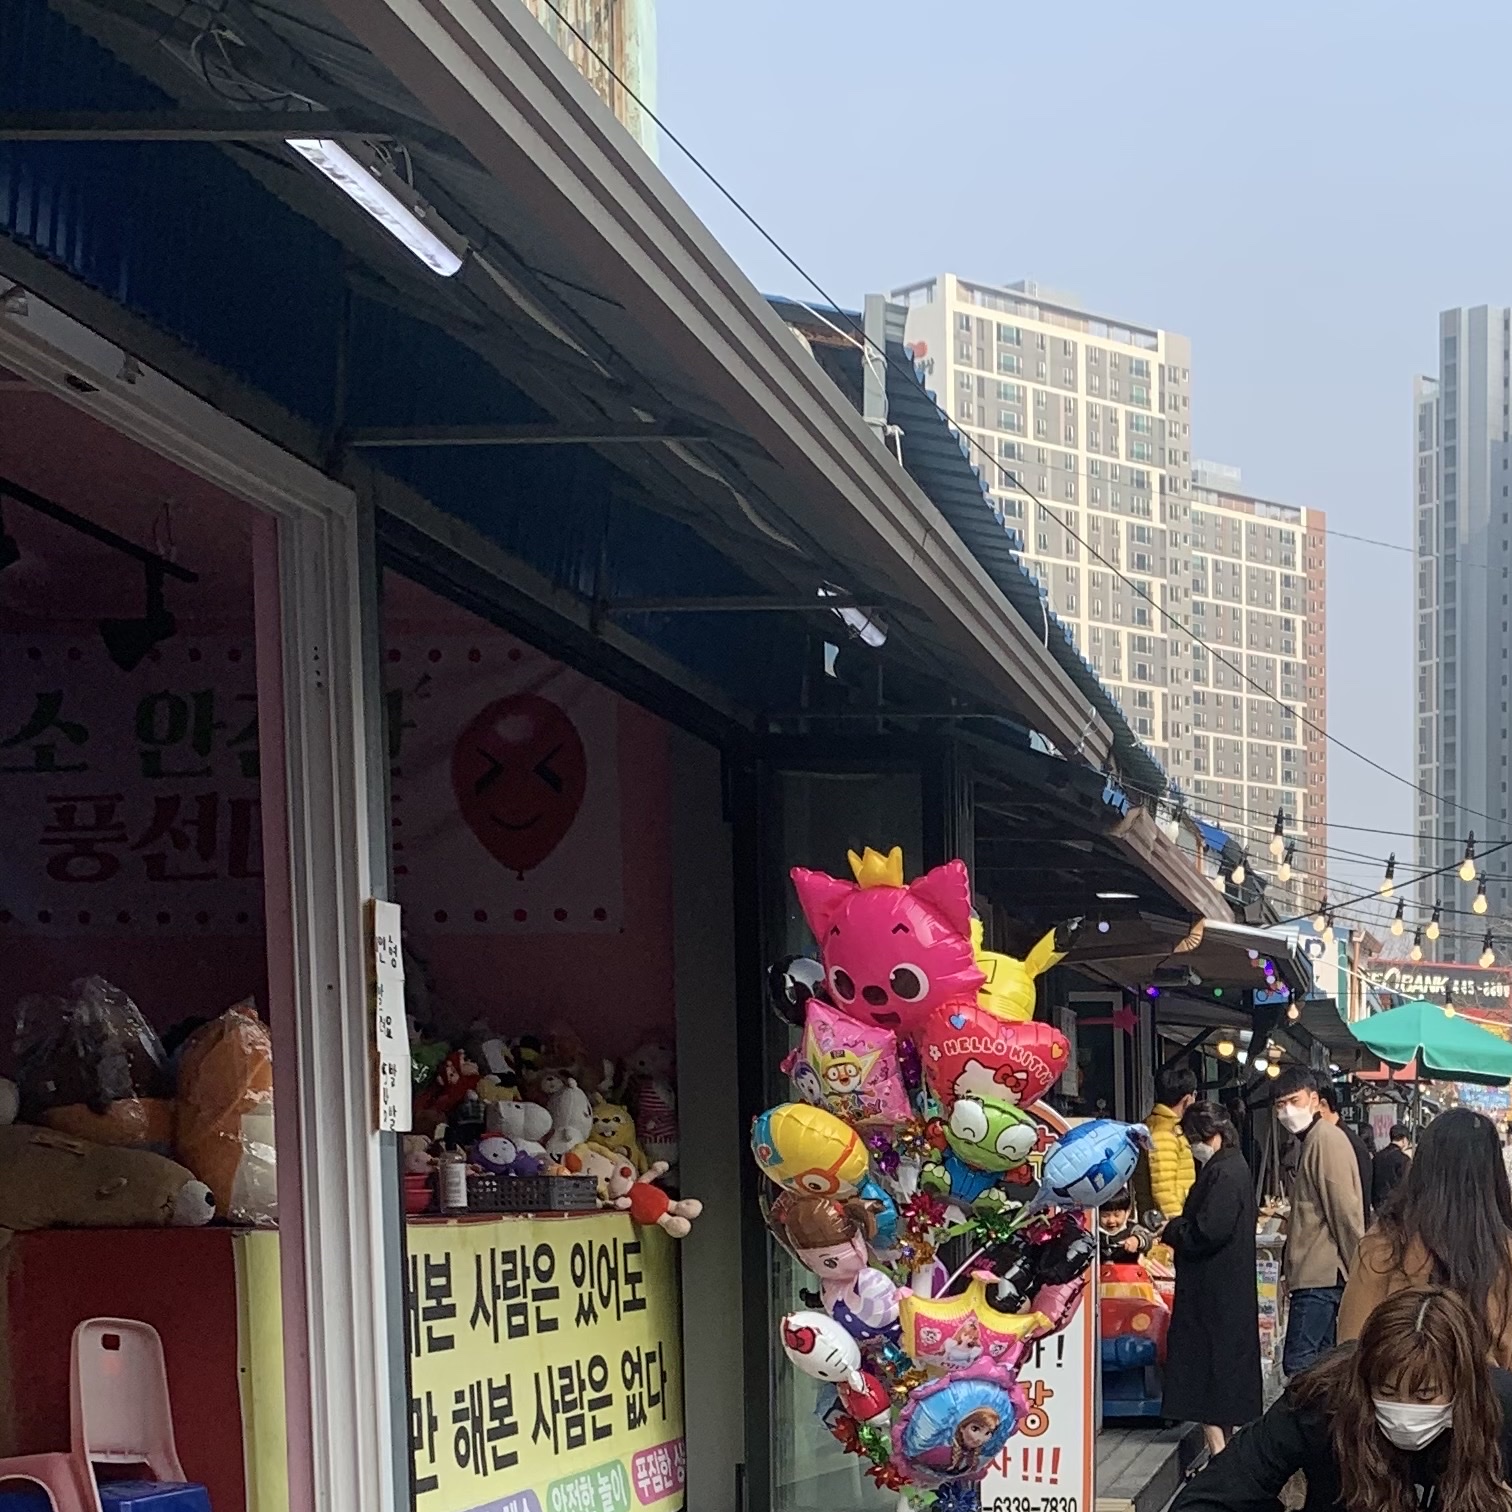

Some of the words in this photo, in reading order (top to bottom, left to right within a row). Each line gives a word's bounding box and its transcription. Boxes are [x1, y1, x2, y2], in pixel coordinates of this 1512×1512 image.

[943, 1036, 1007, 1056] HELLO
[1008, 1045, 1053, 1085] KITTY
[470, 1243, 559, 1343] 사람은
[570, 1238, 646, 1328] 있어도
[452, 1374, 519, 1476] 해본
[532, 1355, 613, 1455] 사람은
[621, 1341, 667, 1431] 없다
[635, 1451, 673, 1497] 푸짐한
